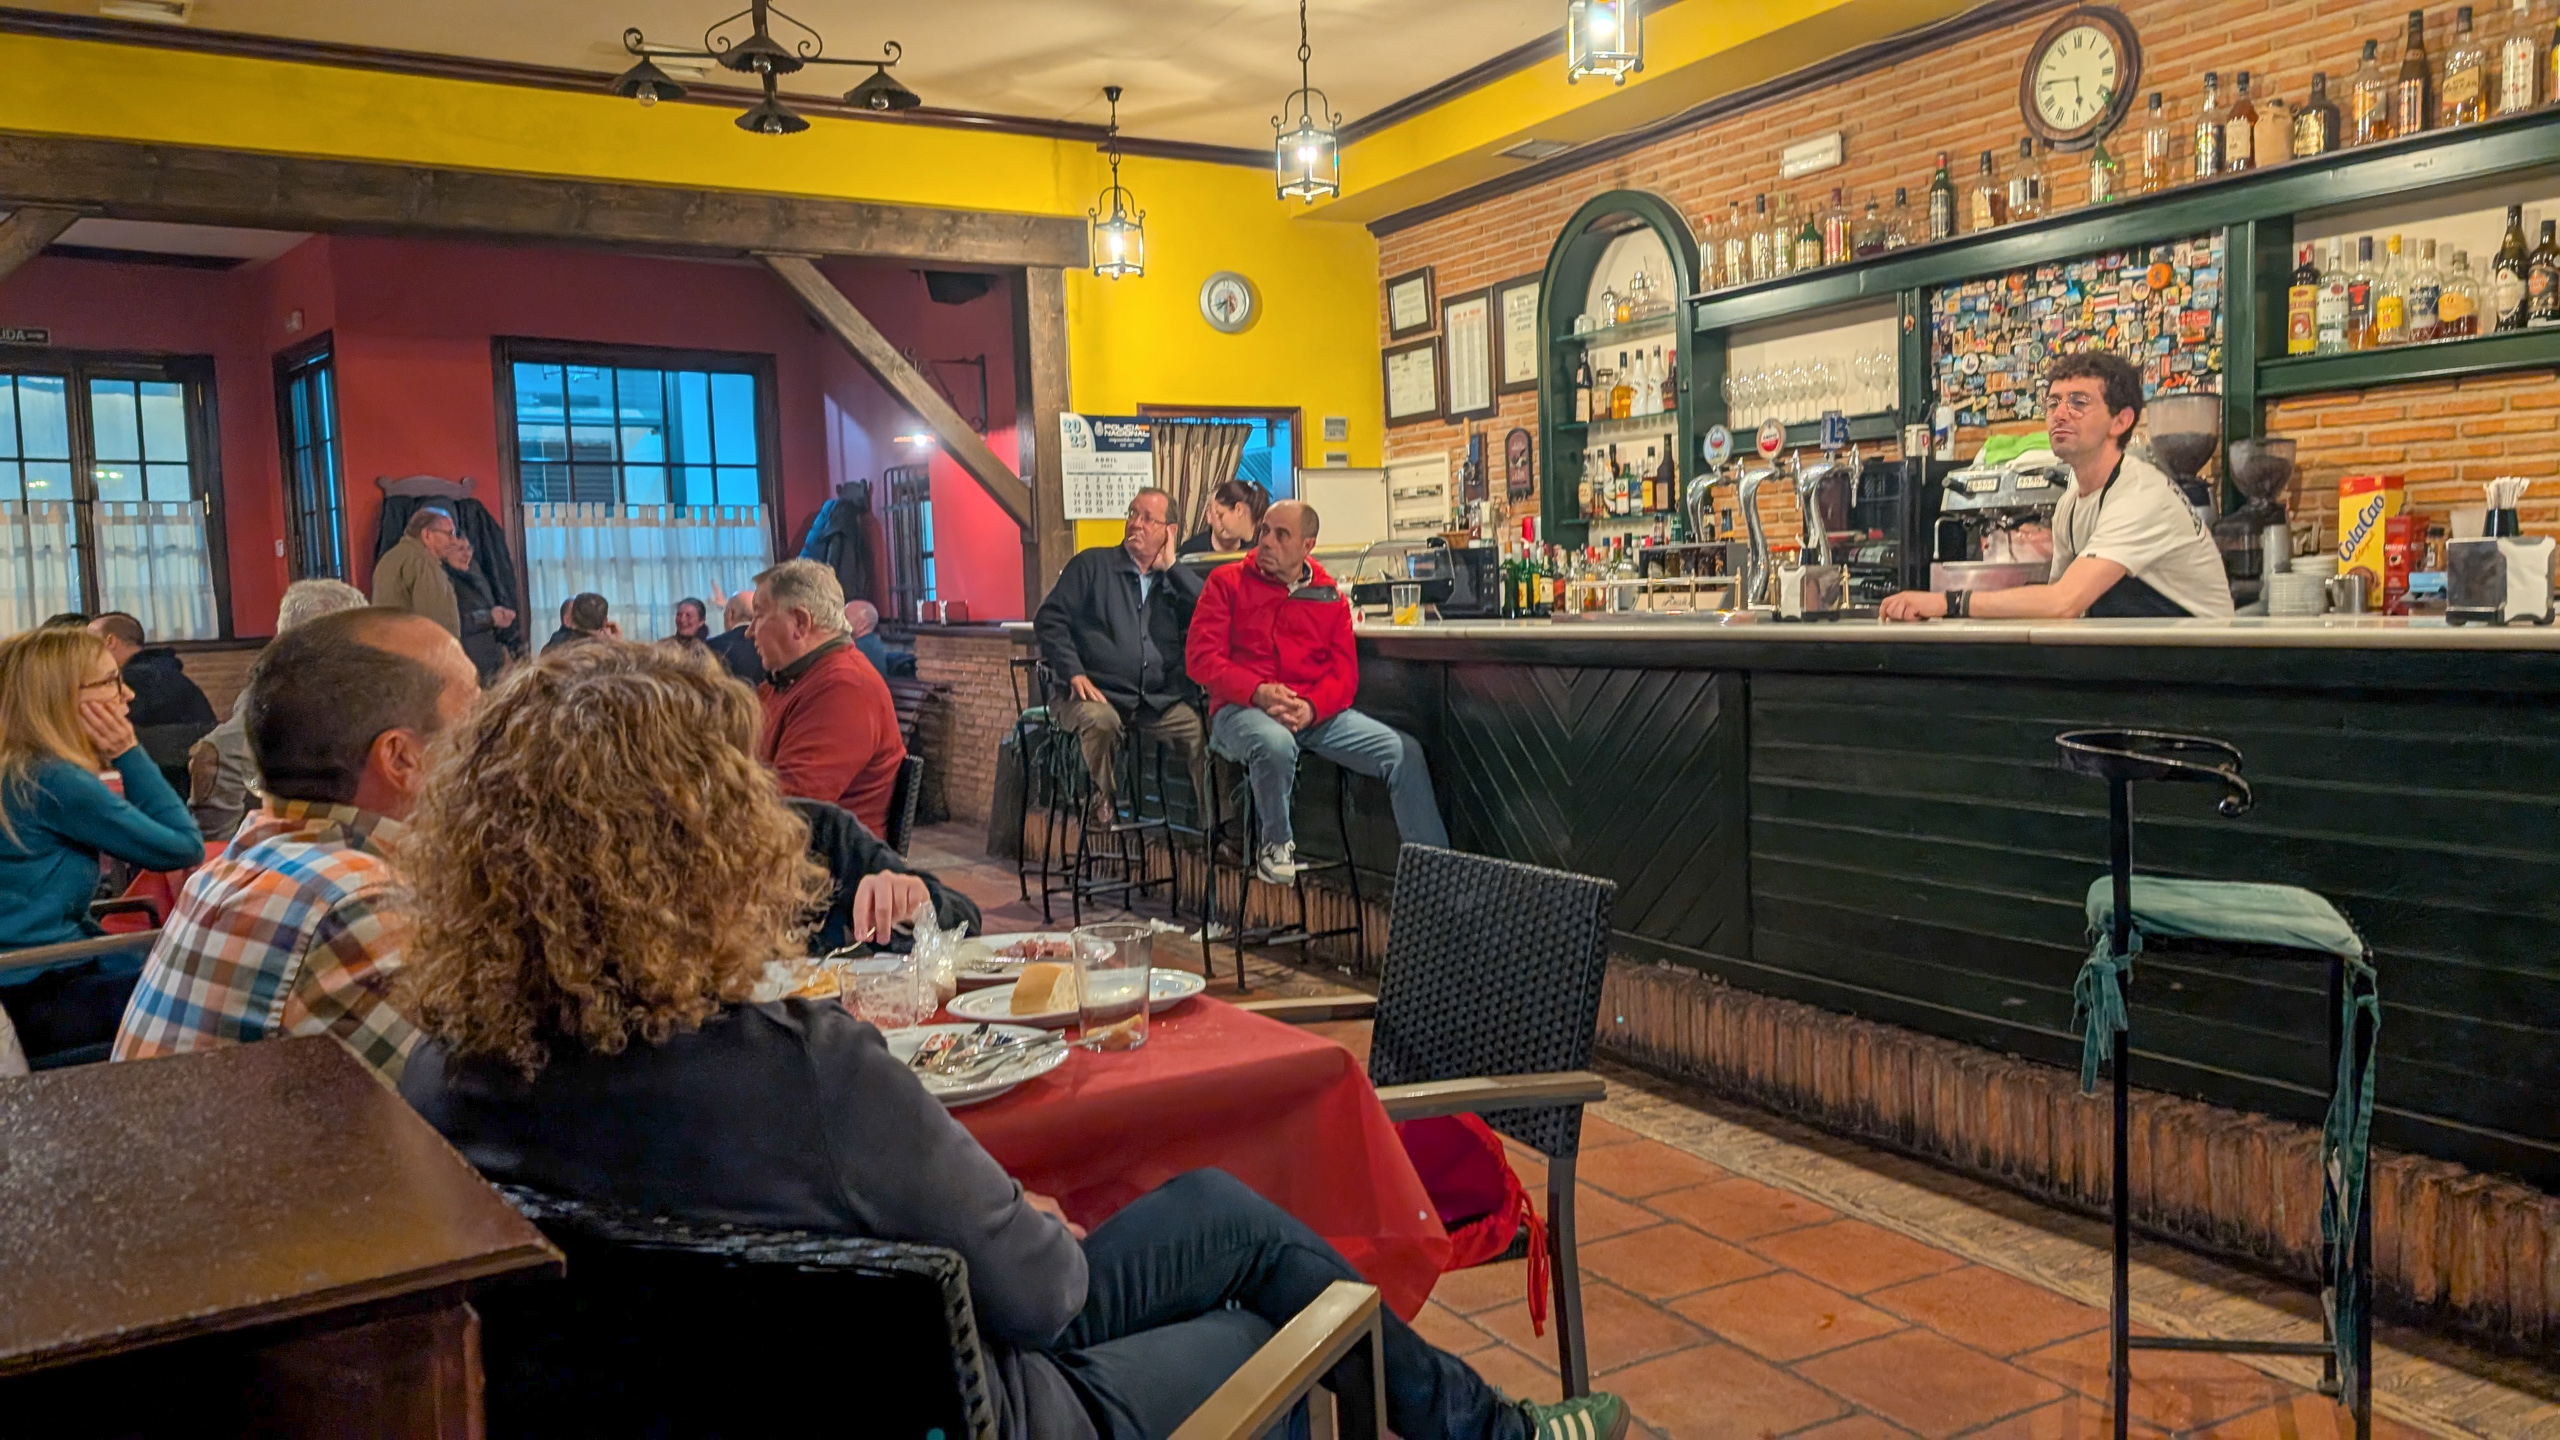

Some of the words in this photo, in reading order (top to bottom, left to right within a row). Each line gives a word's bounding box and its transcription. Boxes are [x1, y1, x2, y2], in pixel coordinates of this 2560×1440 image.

[1062, 419, 1081, 434] 20
[1104, 430, 1146, 438] NACIONAL
[1069, 435, 1087, 449] 25
[2338, 495, 2385, 562] ColaCao
